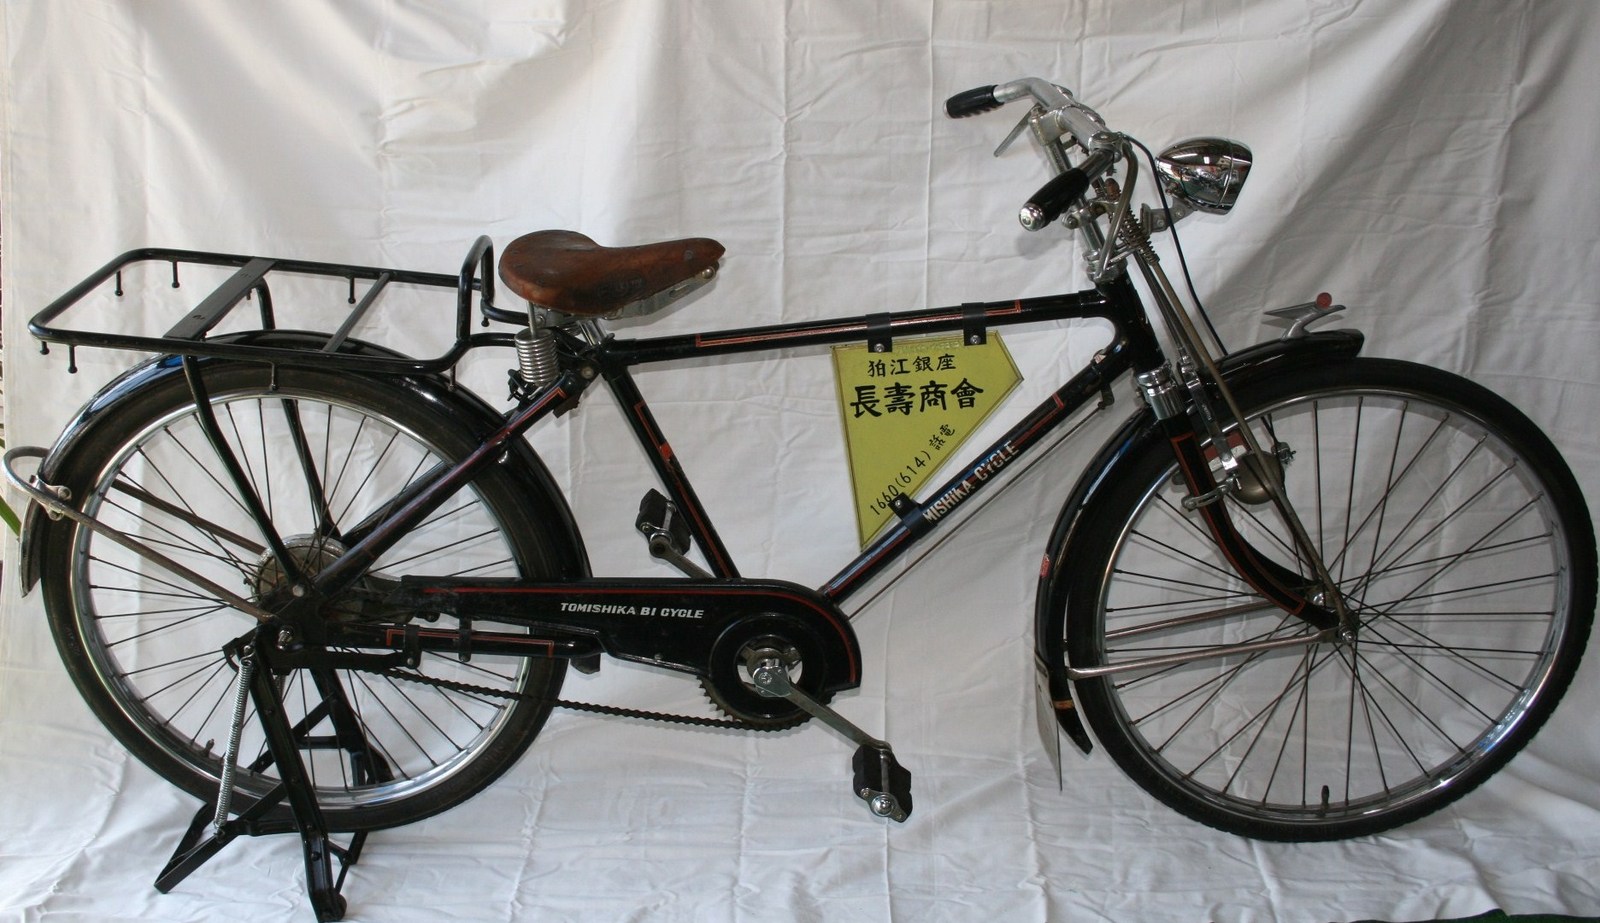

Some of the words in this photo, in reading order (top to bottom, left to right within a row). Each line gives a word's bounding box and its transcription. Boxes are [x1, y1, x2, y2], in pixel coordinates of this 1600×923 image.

[867, 353, 957, 378] 狛江銀座
[850, 377, 984, 419] 長壽商會
[560, 602, 636, 615] TOMISHIKA
[639, 606, 656, 616] BI
[660, 608, 704, 619] CYCLE
